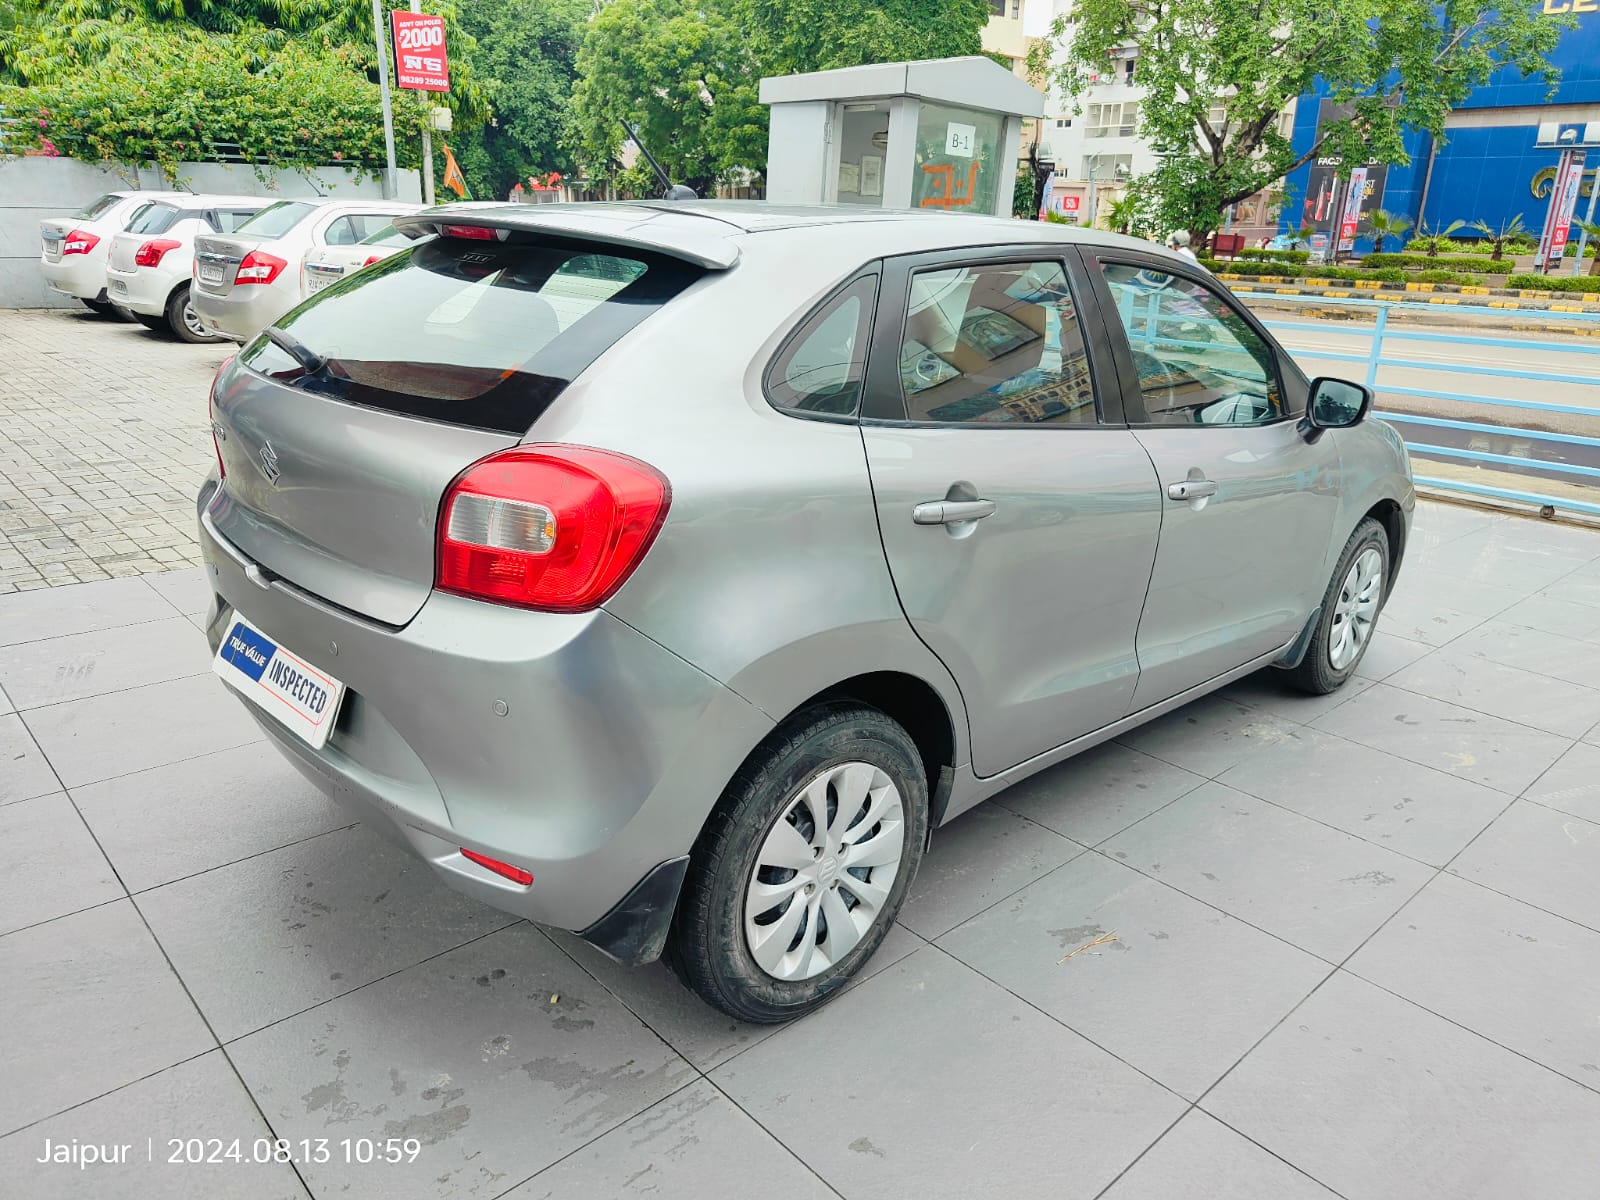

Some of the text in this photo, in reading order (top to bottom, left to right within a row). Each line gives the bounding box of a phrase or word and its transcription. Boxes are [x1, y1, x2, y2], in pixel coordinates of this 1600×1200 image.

[401, 75, 448, 86] 98289 25000
[952, 133, 969, 150] B-1
[229, 636, 266, 667] TRUE VALUE
[268, 658, 327, 714] INSPECTED
